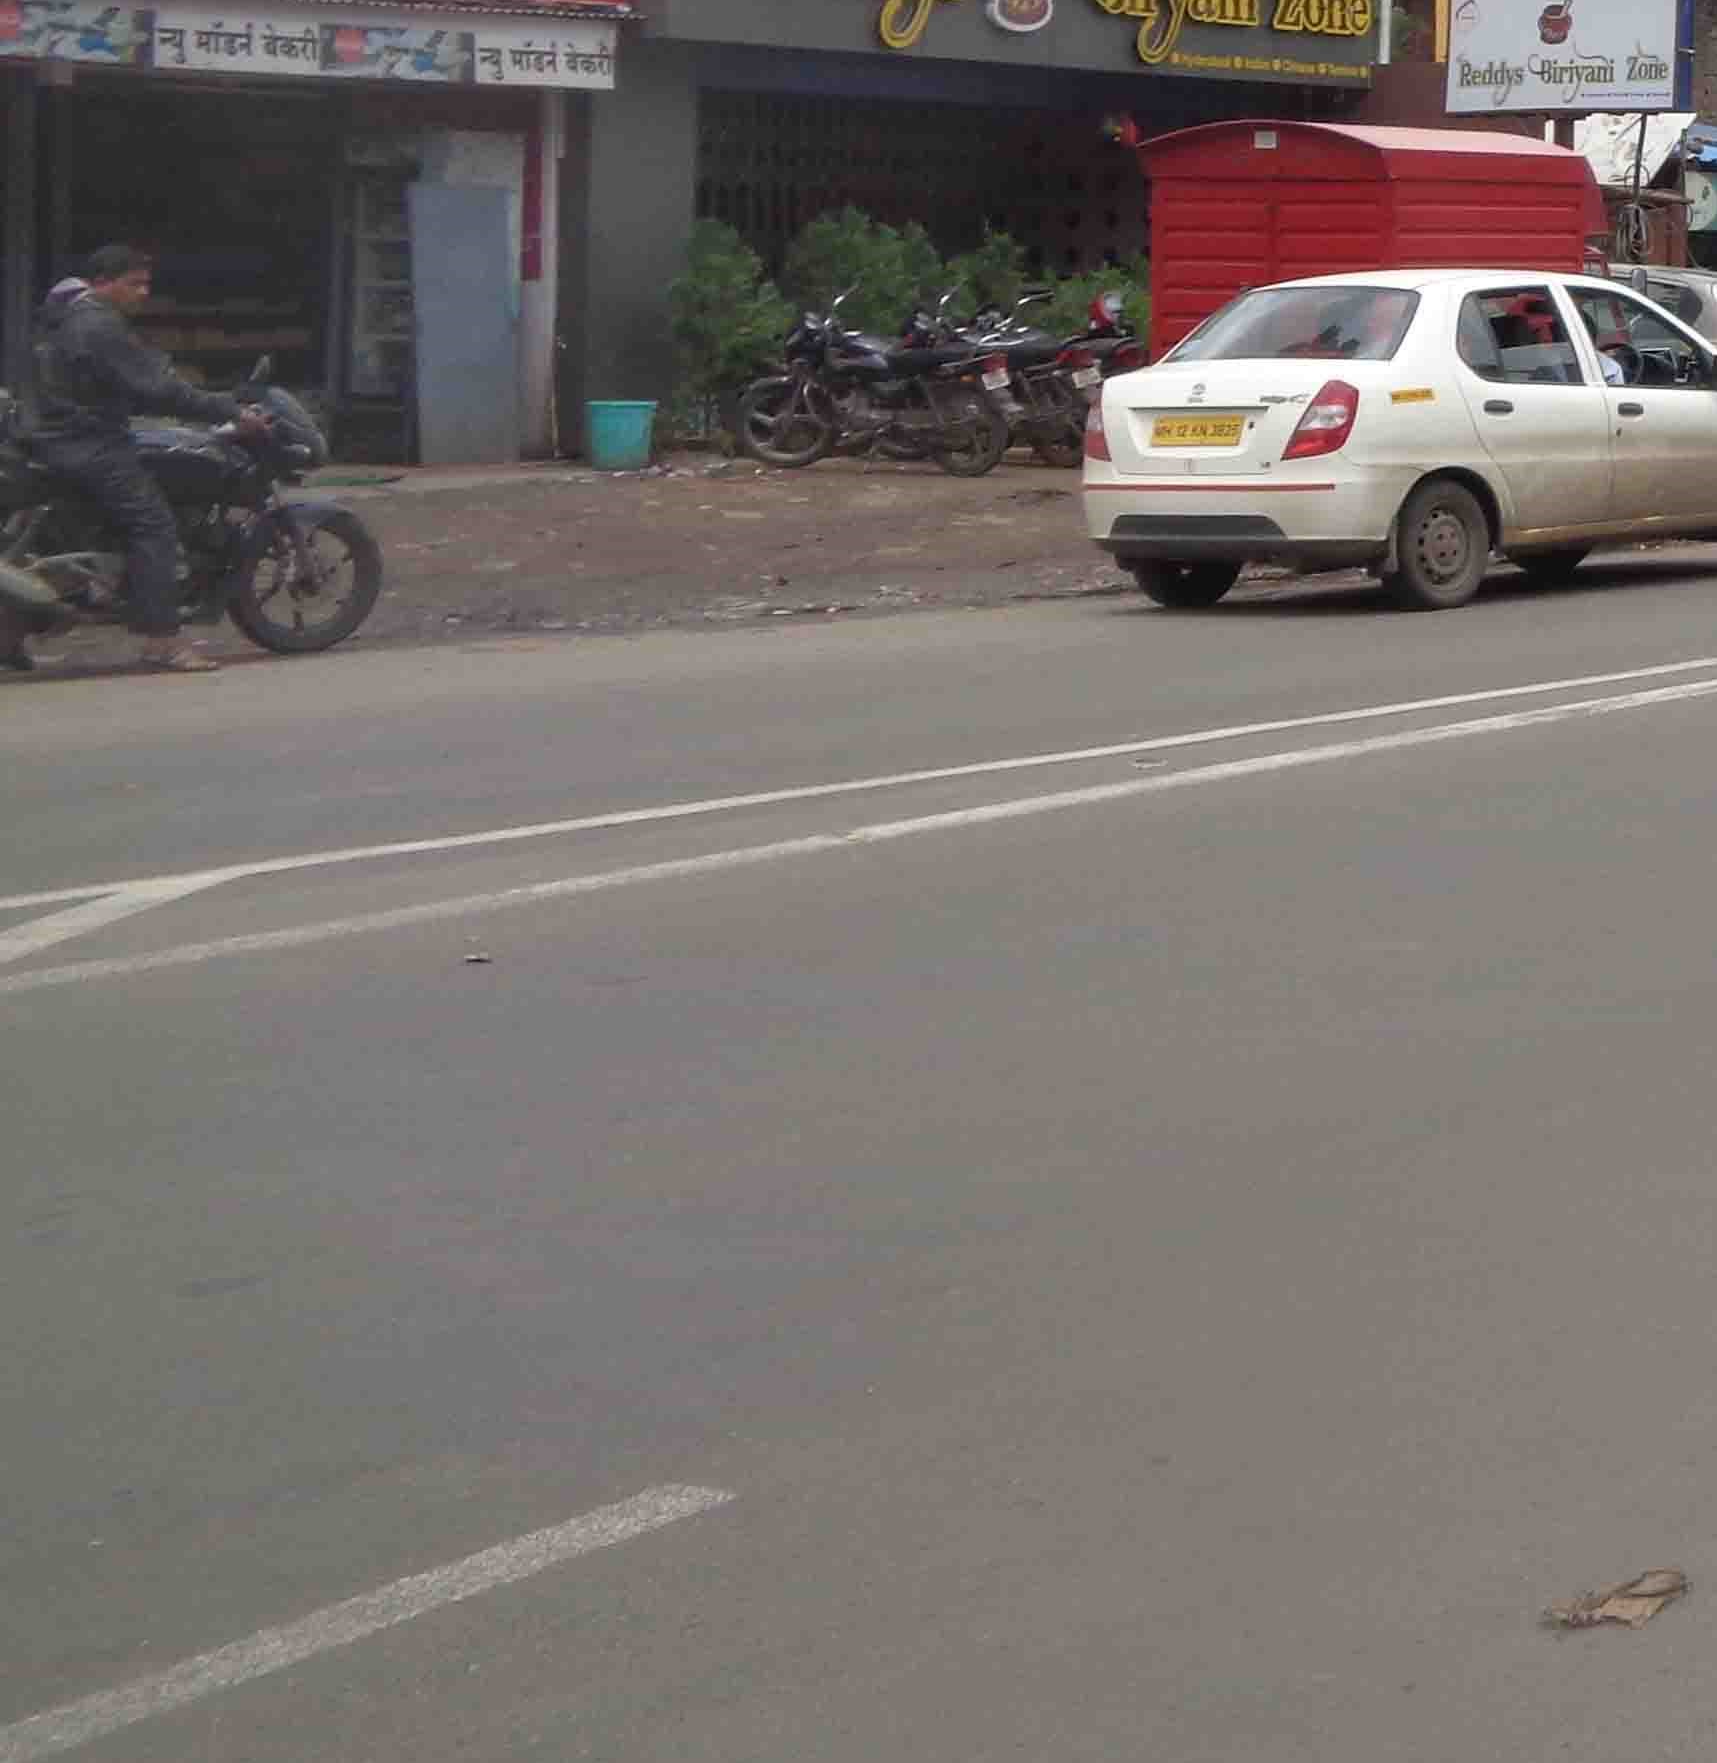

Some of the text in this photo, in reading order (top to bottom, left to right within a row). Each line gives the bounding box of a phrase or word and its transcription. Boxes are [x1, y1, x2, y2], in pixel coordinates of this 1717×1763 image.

[1456, 40, 1669, 106] Reddys Biriyani Zone
